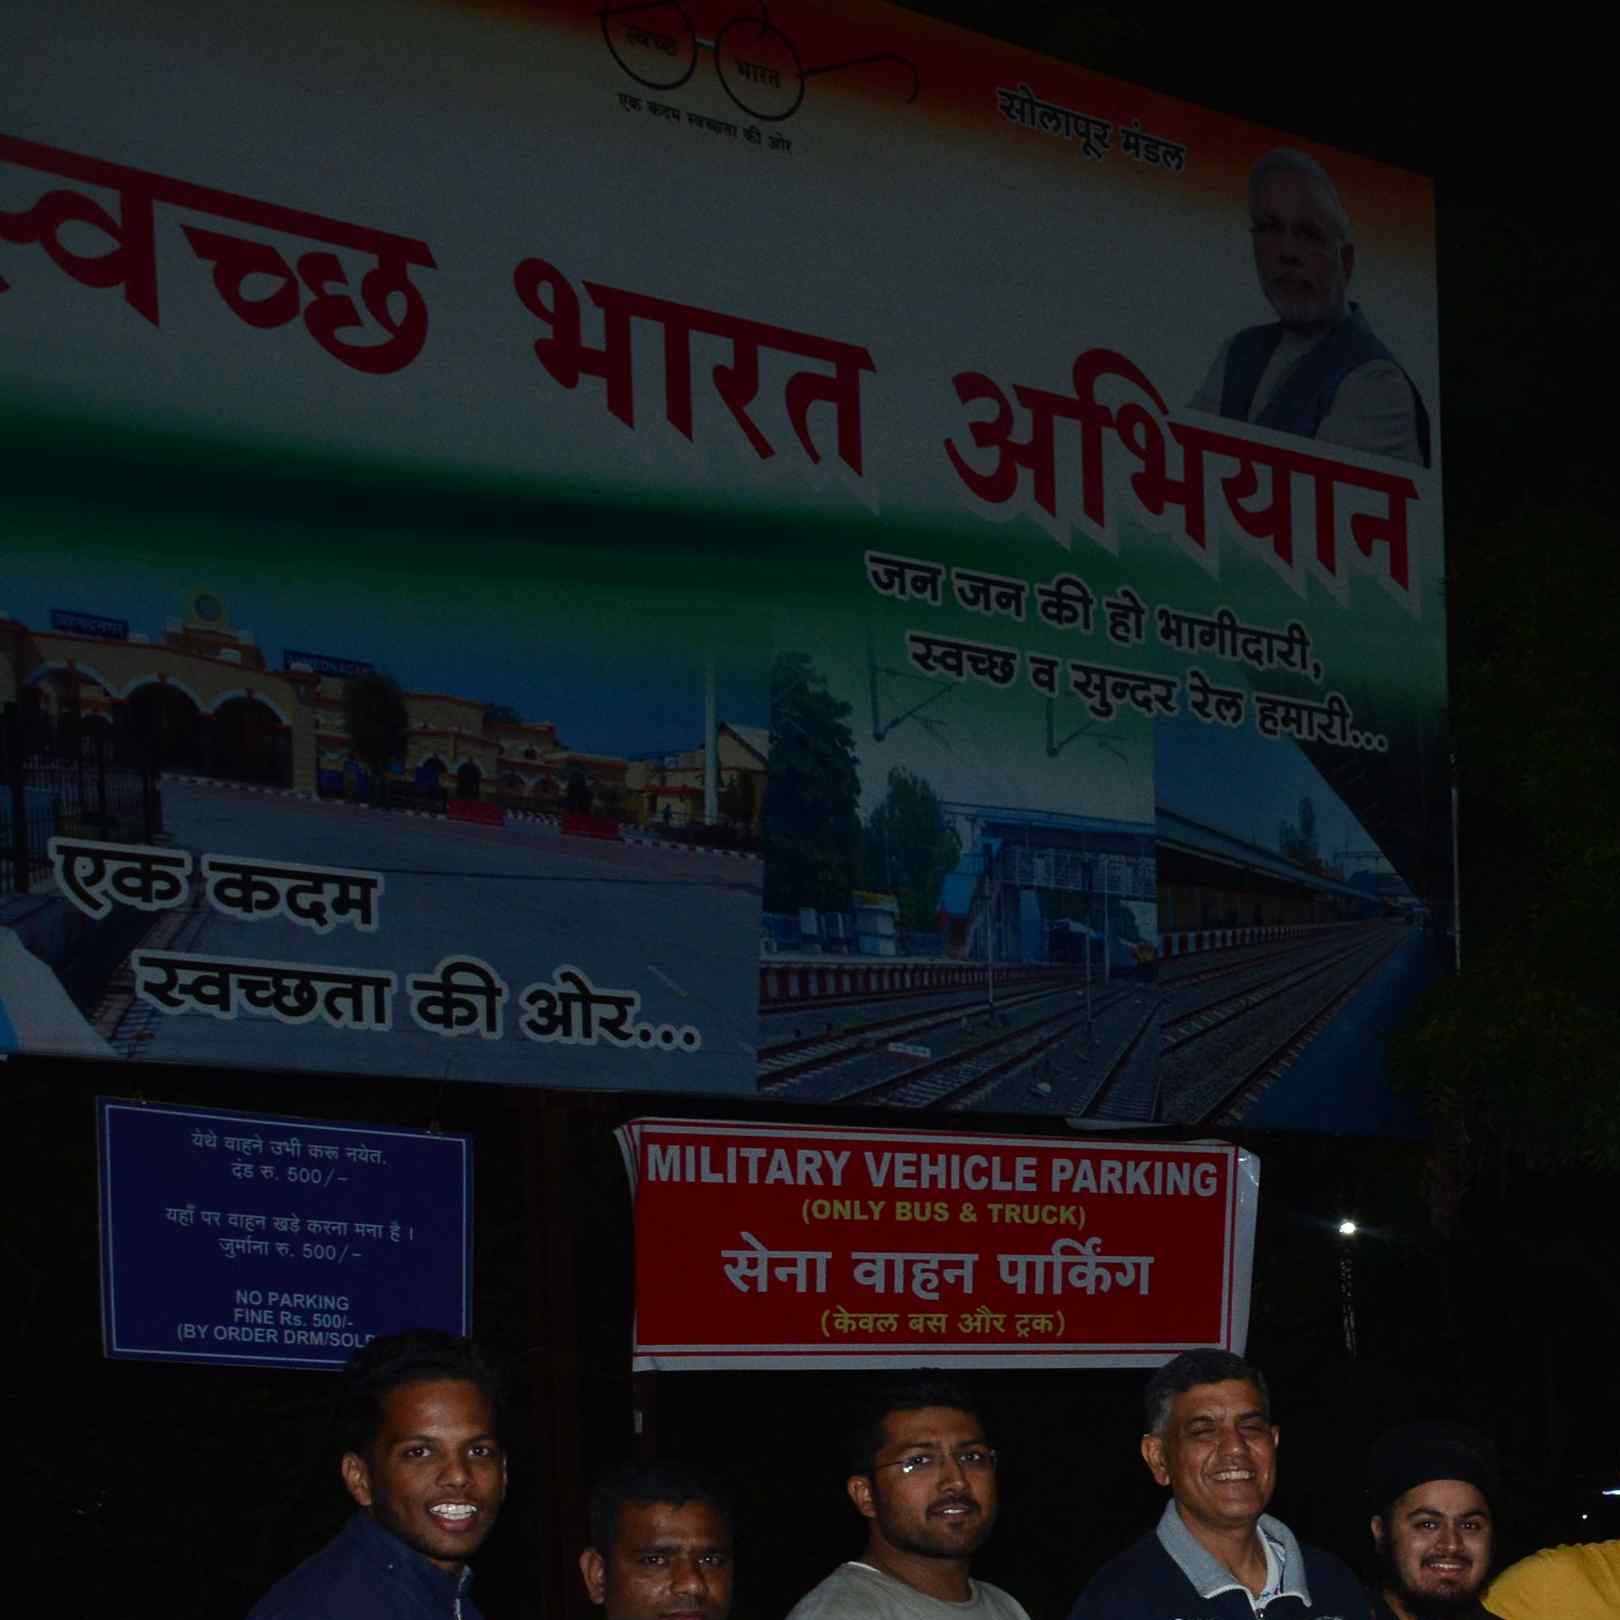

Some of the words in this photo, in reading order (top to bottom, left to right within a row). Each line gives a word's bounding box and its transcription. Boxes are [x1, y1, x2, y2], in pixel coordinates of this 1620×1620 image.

[1120, 119, 1185, 171] मंडल
[514, 258, 877, 478] भारत
[945, 348, 1420, 592] अभियान
[868, 553, 940, 602] जन
[958, 568, 1025, 616] जन
[1038, 577, 1093, 632] की
[1106, 588, 1145, 644] हो
[1159, 607, 1324, 682] भागीदारी,
[909, 634, 1018, 685] स्वच्छ
[1030, 656, 1058, 694] व
[1072, 663, 1178, 719] सुन्दर
[1189, 671, 1243, 726] रेल
[56, 845, 186, 912] एक
[209, 861, 378, 930] कदम
[139, 956, 391, 1024] स्वच्छता
[413, 961, 503, 1034] की
[224, 1133, 264, 1156] वाहने
[269, 1136, 302, 1159] उभी
[231, 1158, 255, 1179] दंड
[646, 1143, 852, 1187] MILITARY
[863, 1150, 1038, 1193] VEHICLE
[1050, 1156, 1218, 1198] PARKING
[200, 1210, 222, 1228] पर
[227, 1212, 267, 1233] वाहन
[306, 1218, 349, 1238] करना
[354, 1221, 384, 1239] मना
[389, 1219, 402, 1243] है
[800, 1199, 882, 1225] (ONLY
[895, 1200, 950, 1224] BUS
[960, 1203, 979, 1224] &
[987, 1203, 1087, 1230] TRUCK)
[720, 1232, 833, 1295] सेना
[852, 1249, 980, 1302] वाहन
[233, 1308, 275, 1326] FINE
[280, 1311, 307, 1328] Rs.
[312, 1312, 354, 1329] 500/-
[235, 1288, 262, 1306] NO
[267, 1291, 350, 1312] PARKING
[819, 1305, 899, 1338] (केवल
[907, 1310, 949, 1336] बस
[959, 1304, 1008, 1336] और
[176, 1322, 209, 1344] (BY
[213, 1324, 279, 1345] ORDER
